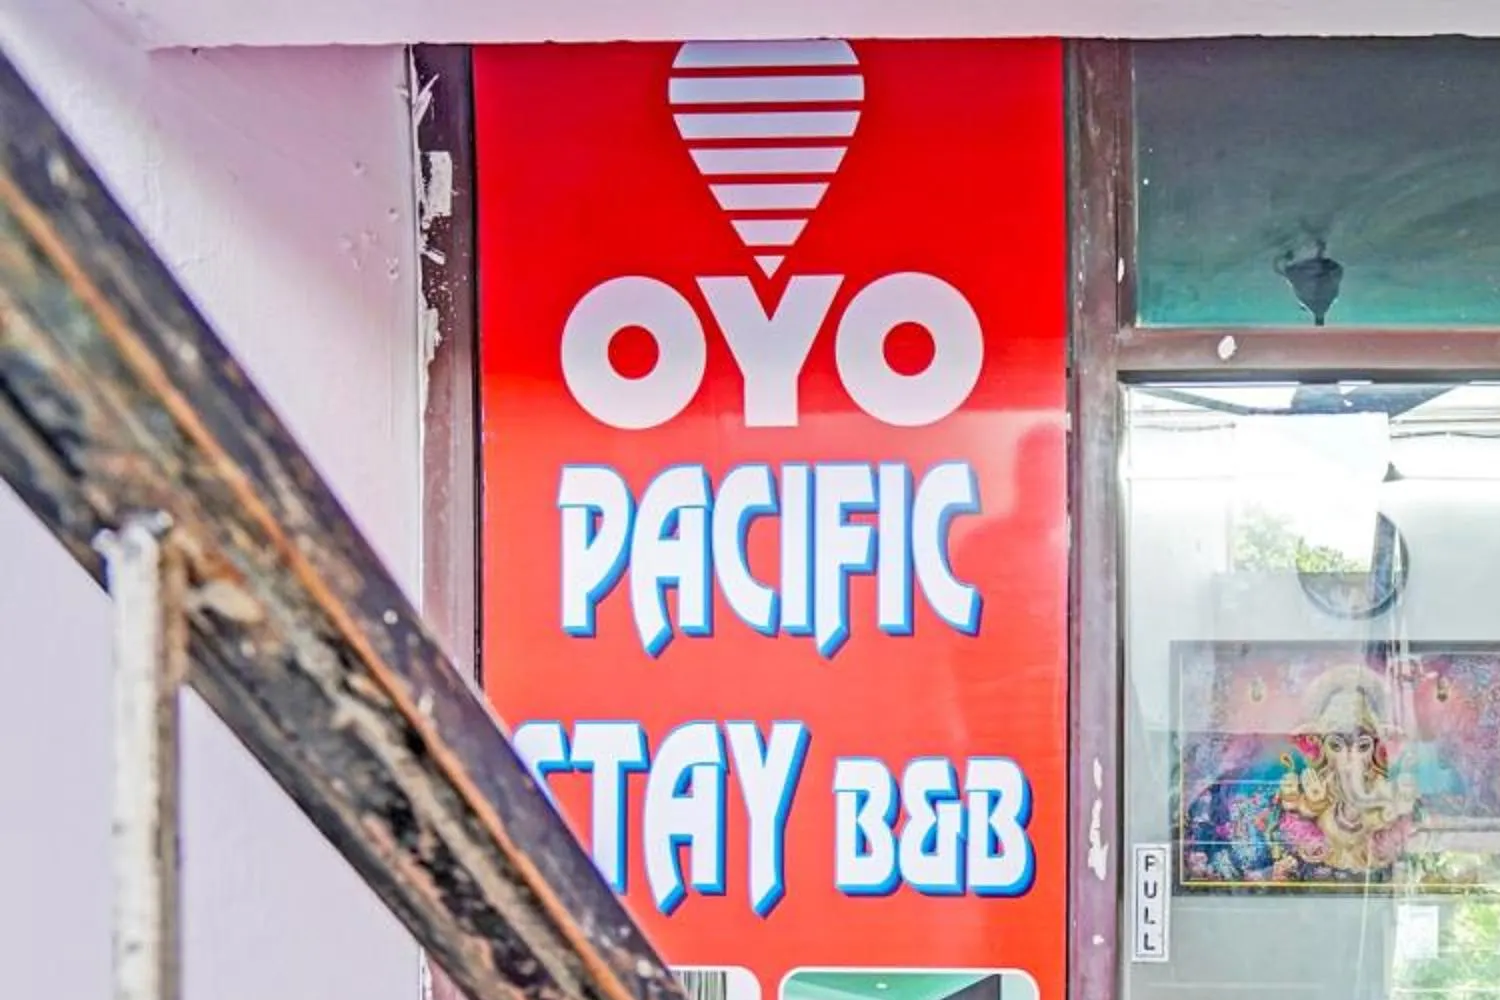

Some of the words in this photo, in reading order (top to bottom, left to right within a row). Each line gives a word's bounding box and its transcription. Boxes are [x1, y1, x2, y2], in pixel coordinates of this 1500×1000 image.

[560, 271, 984, 429] OYO
[557, 462, 984, 657] PACIFIC
[832, 757, 1036, 898] B&B
